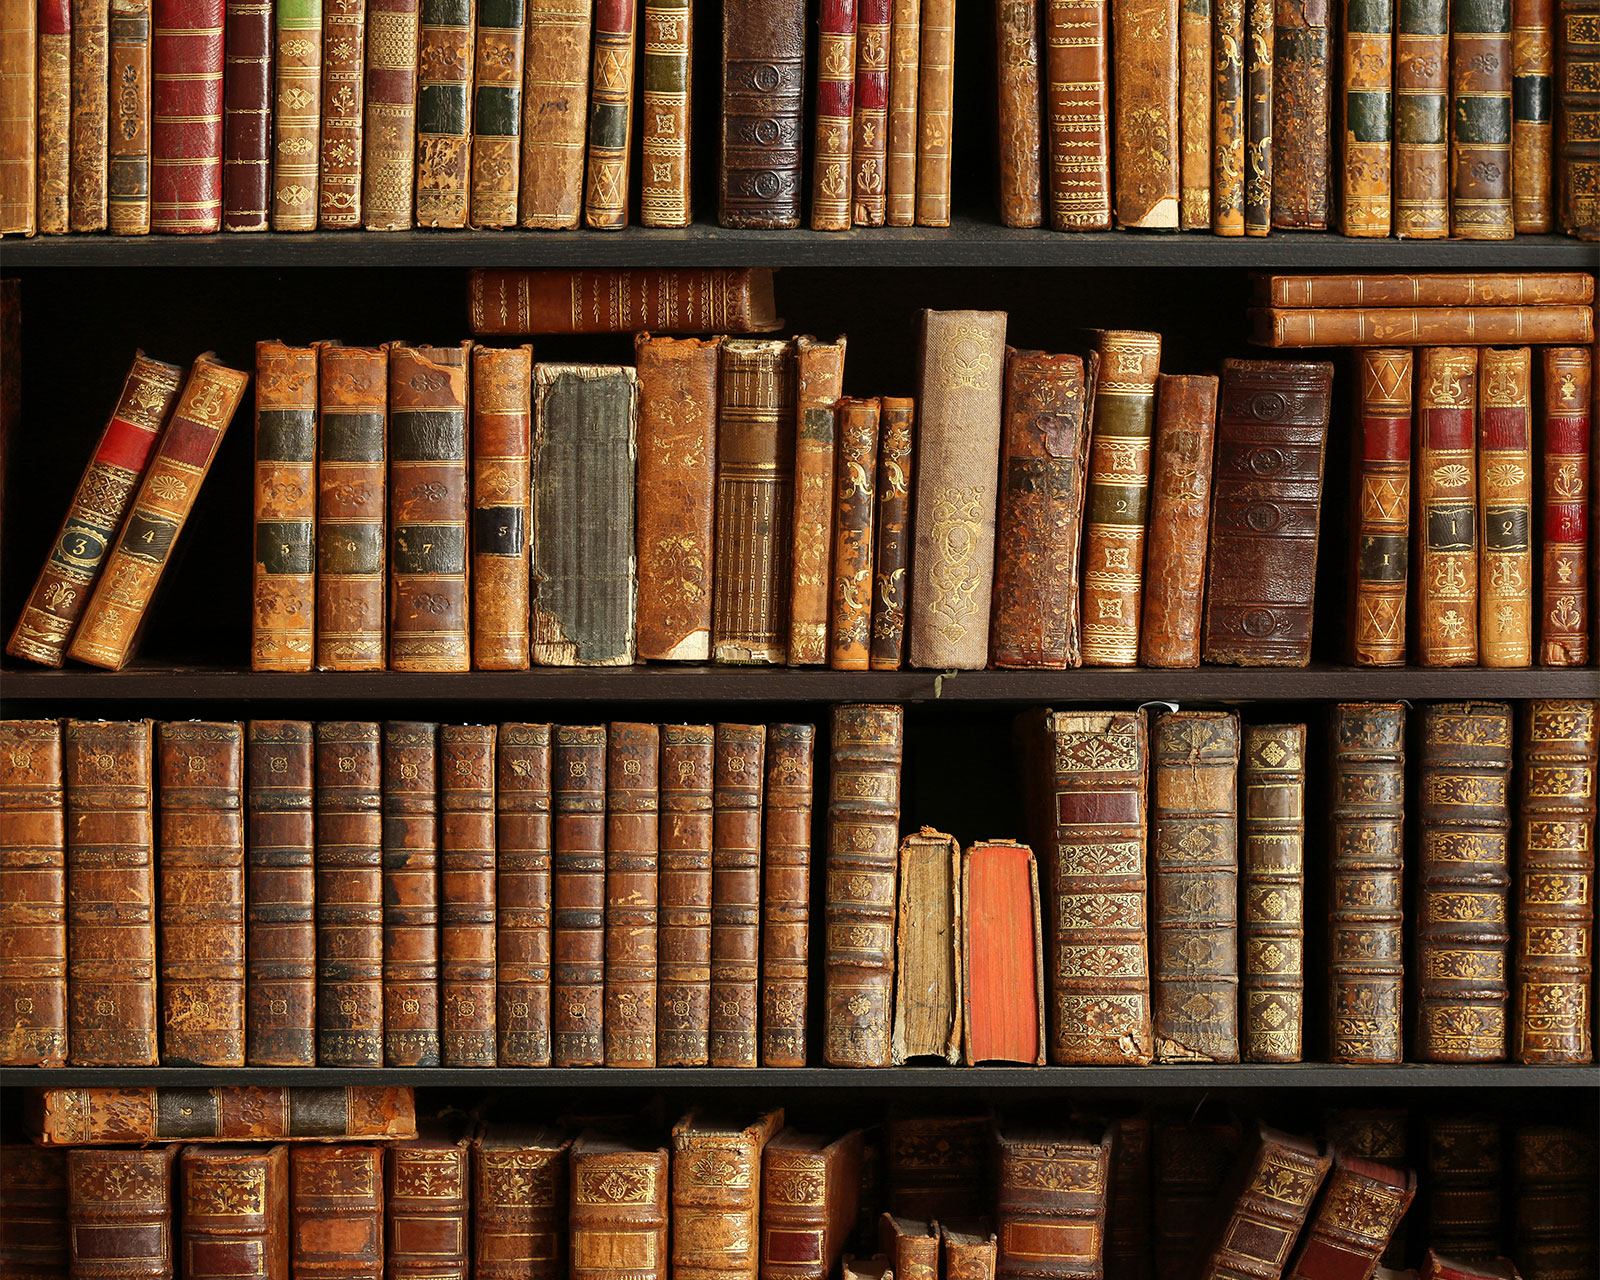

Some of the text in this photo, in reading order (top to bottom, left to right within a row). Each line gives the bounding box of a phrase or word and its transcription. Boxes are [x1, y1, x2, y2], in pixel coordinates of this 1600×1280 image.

[1116, 500, 1127, 513] 2
[1452, 520, 1457, 535] 1
[1503, 521, 1513, 535] 2
[143, 529, 155, 543] 4
[73, 539, 87, 555] 3
[280, 544, 290, 554] 5
[347, 541, 357, 552] 6
[423, 544, 432, 554] 7
[852, 541, 859, 549] 2
[181, 1107, 192, 1116] 2
